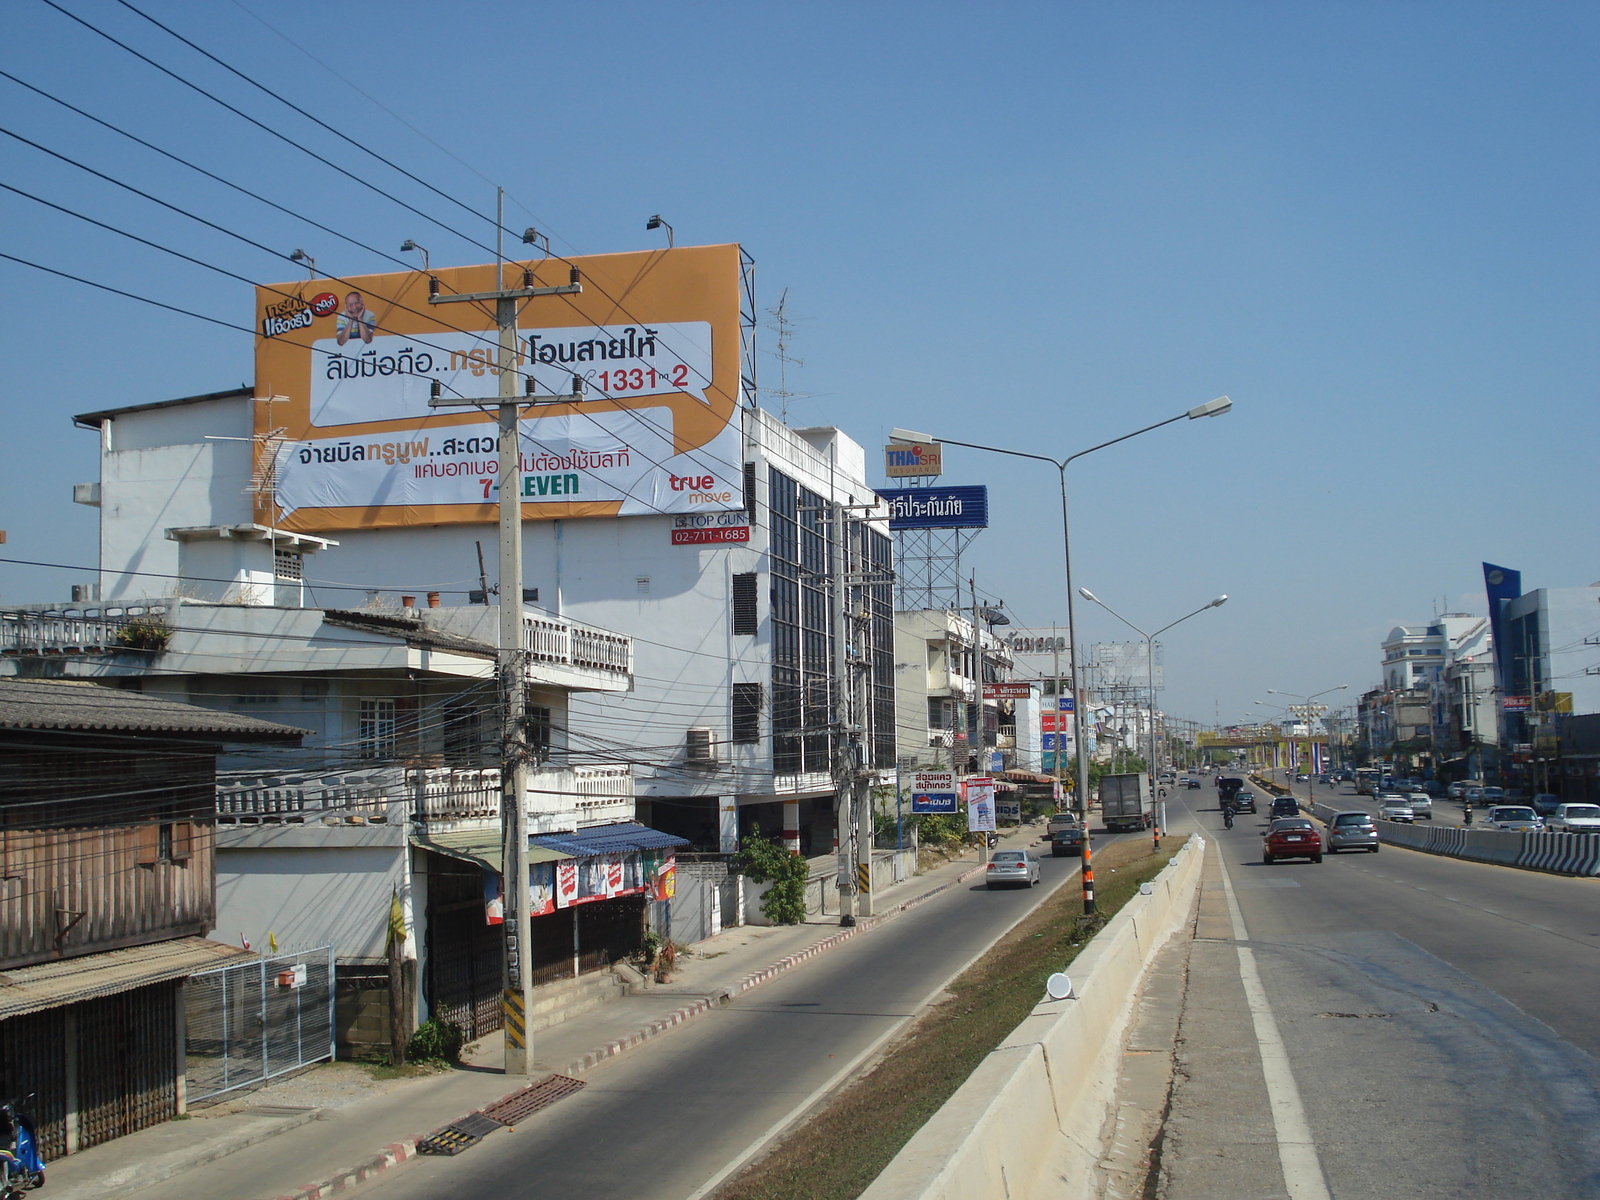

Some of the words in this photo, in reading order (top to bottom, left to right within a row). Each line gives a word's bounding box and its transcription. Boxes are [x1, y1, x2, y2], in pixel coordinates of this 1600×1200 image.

[599, 368, 656, 391] 1331
[672, 364, 688, 387] 2
[669, 474, 715, 491] true
[688, 491, 732, 504] move
[688, 515, 714, 527] TOP
[717, 513, 746, 526] GUN
[675, 529, 746, 542] 02-711-1685
